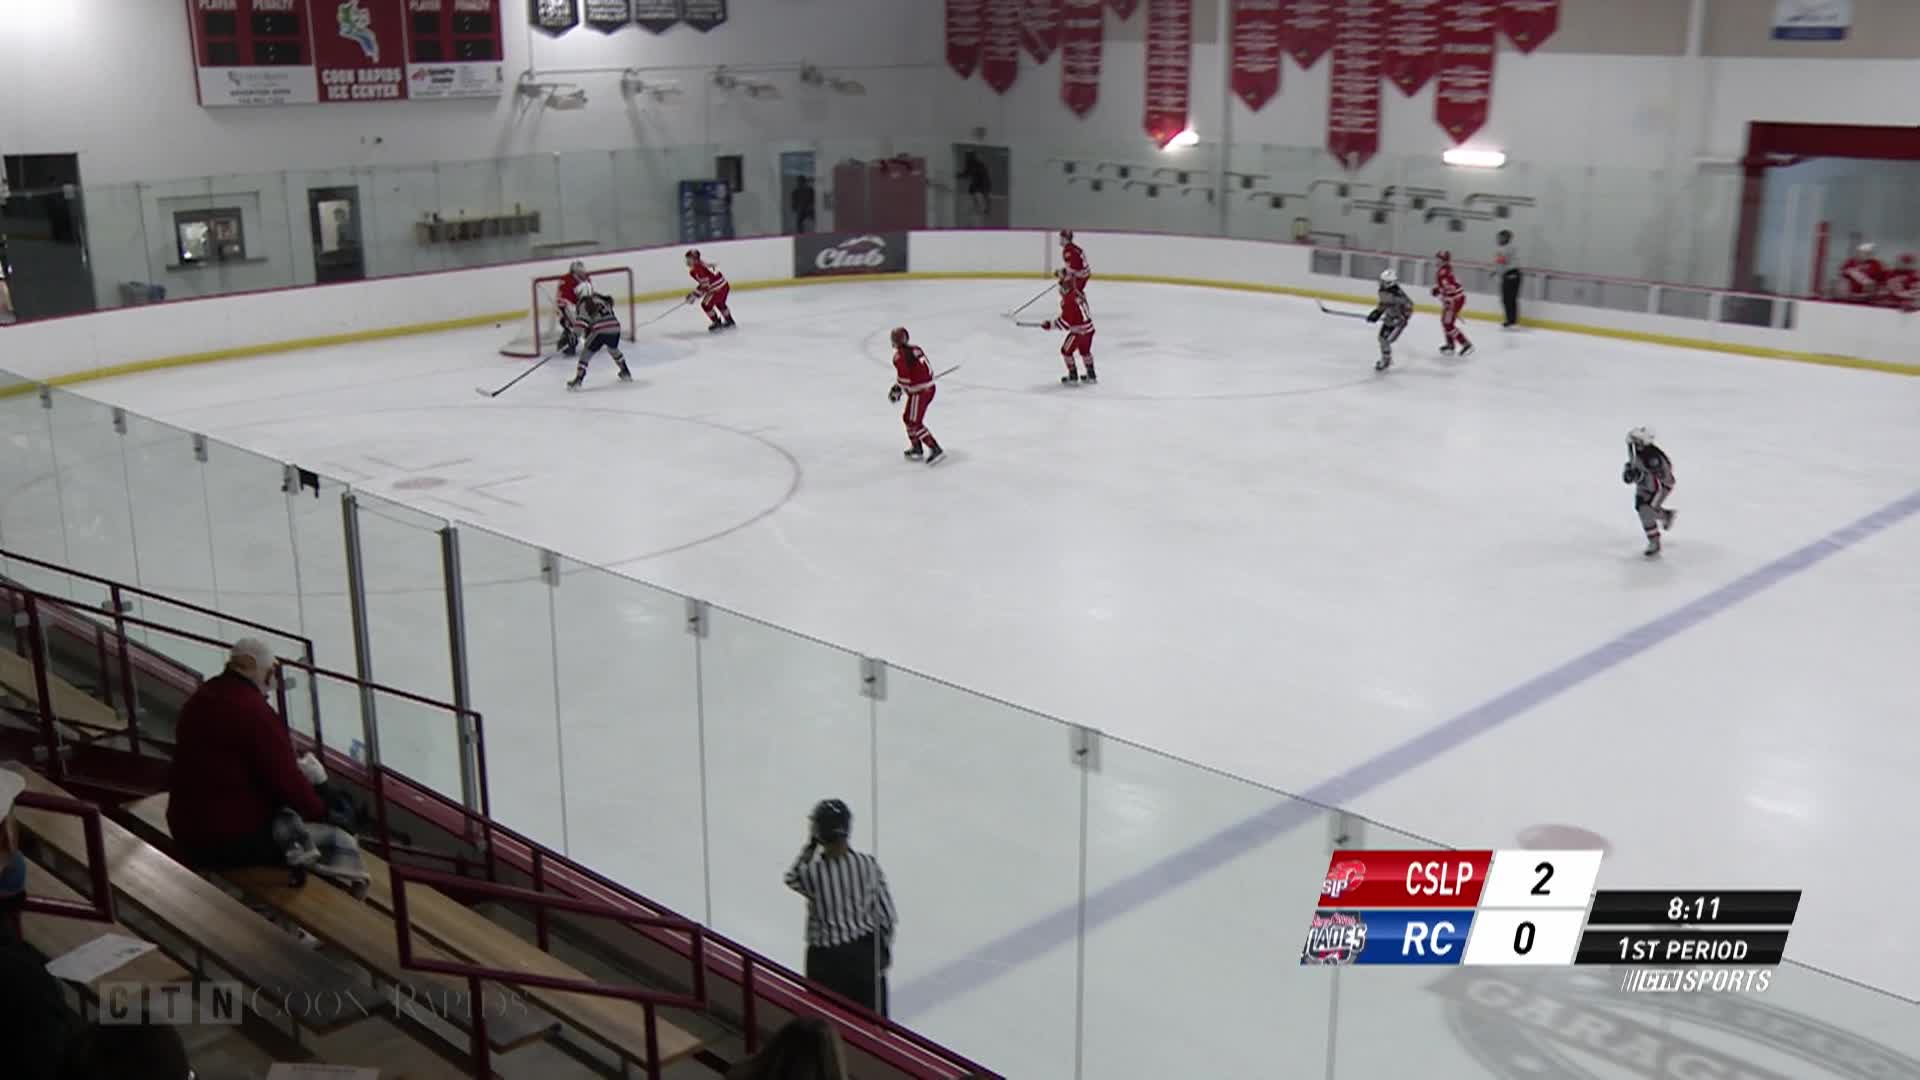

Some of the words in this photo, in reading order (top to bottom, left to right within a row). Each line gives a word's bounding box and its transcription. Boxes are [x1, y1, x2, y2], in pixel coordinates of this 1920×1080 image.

[321, 69, 355, 84] COON
[357, 67, 402, 82] RAPIDS
[327, 85, 349, 99] ICE
[351, 83, 399, 98] CENTER
[815, 247, 886, 269] Club
